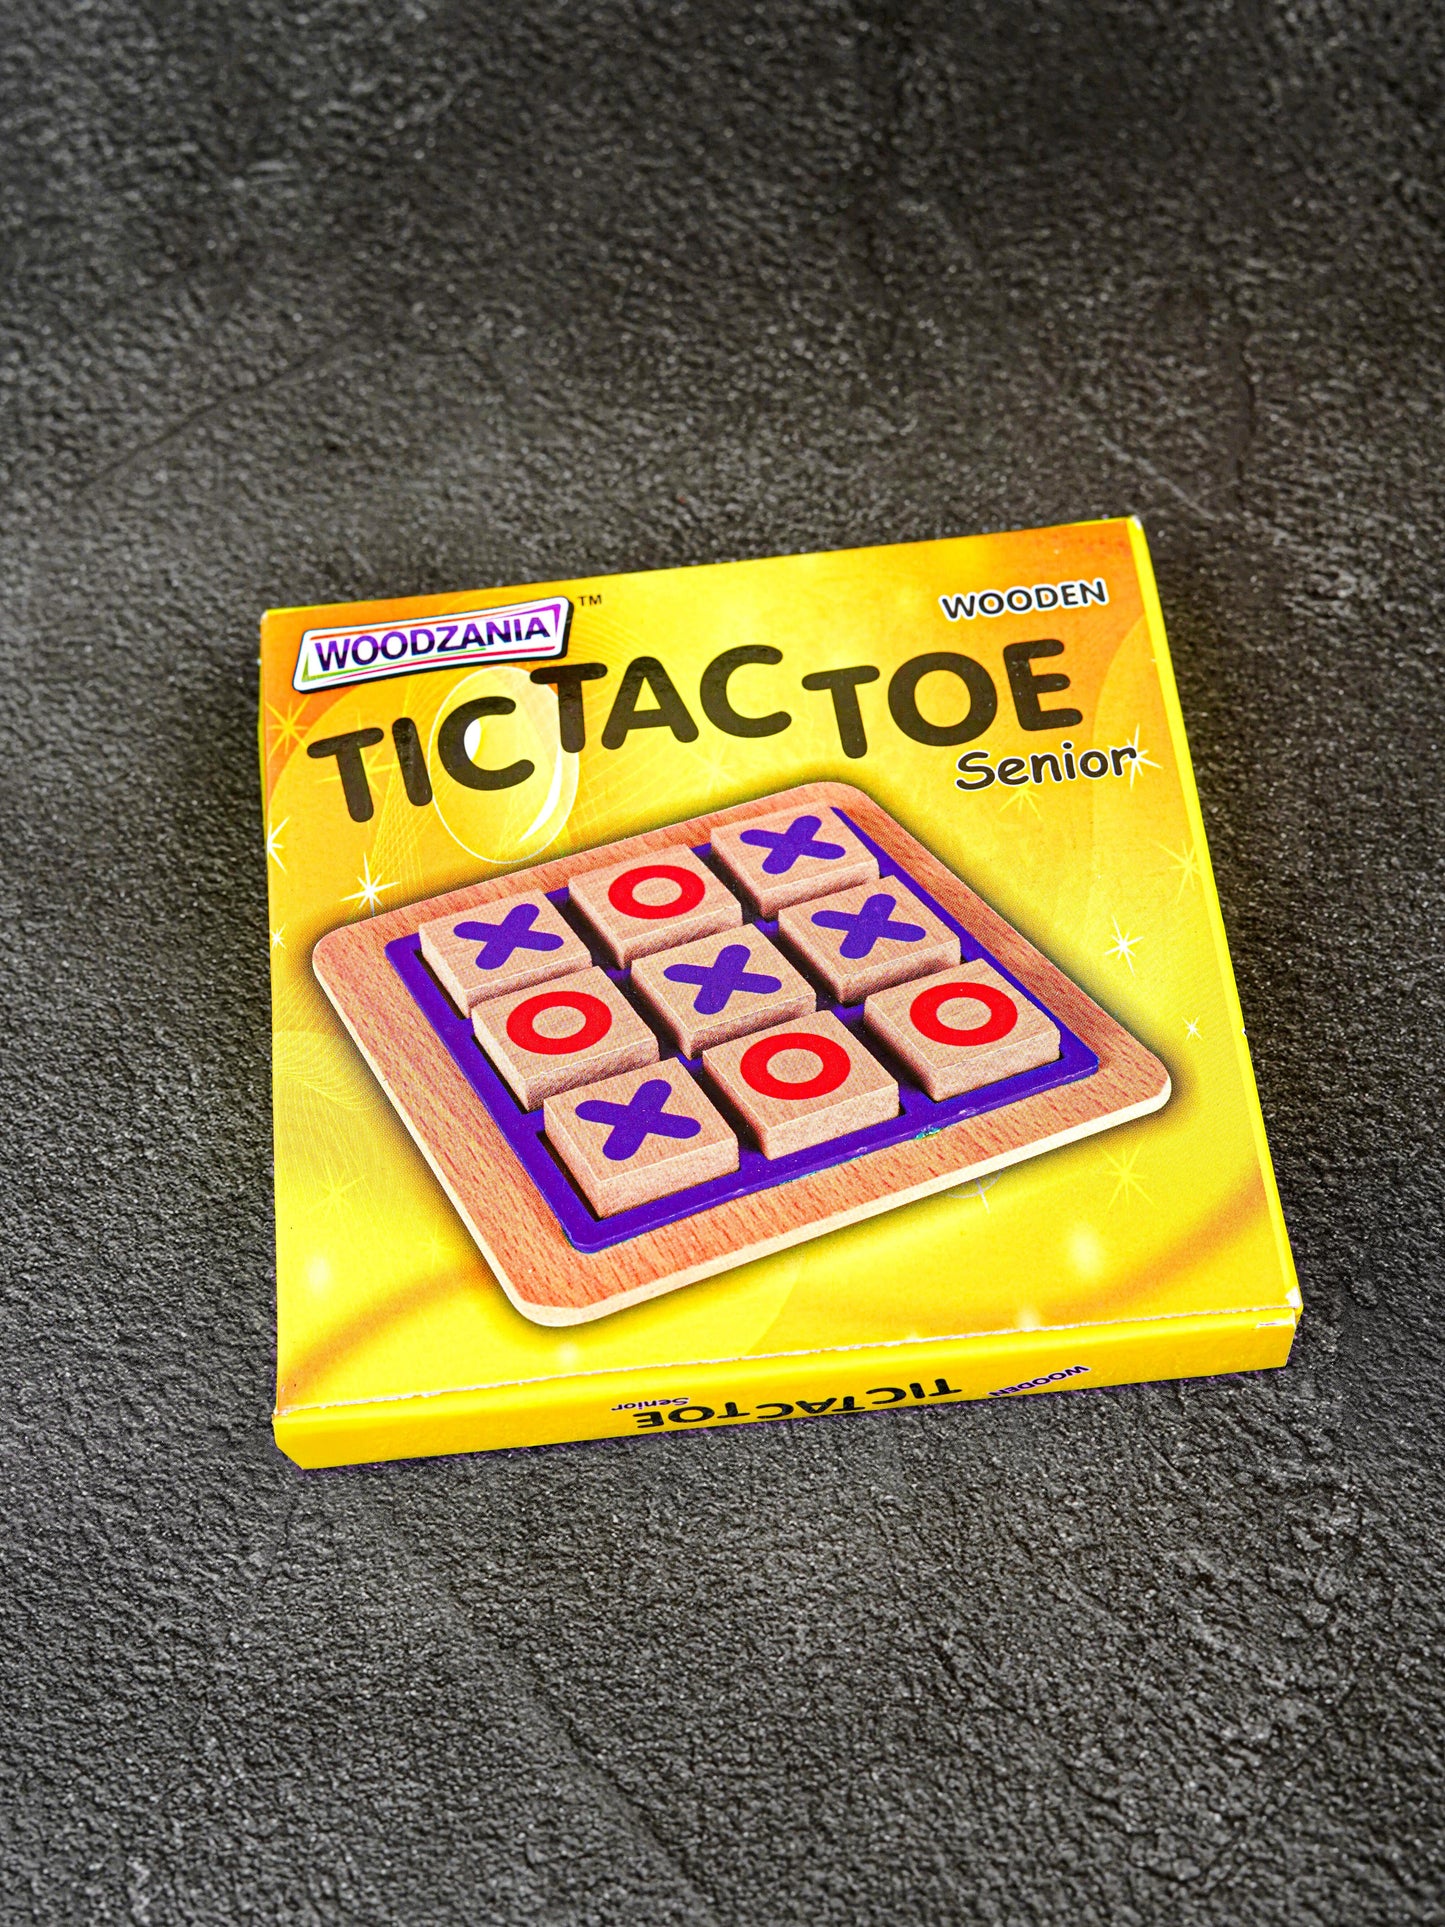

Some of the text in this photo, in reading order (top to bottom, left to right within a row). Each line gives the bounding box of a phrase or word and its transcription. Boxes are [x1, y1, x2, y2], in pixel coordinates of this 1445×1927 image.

[941, 580, 1107, 620] WOODEN
[315, 594, 603, 672] WOODZANIA TM
[955, 741, 1138, 790] Senior
[987, 1365, 1091, 1397] WOODEN
[610, 1397, 690, 1412] Senior
